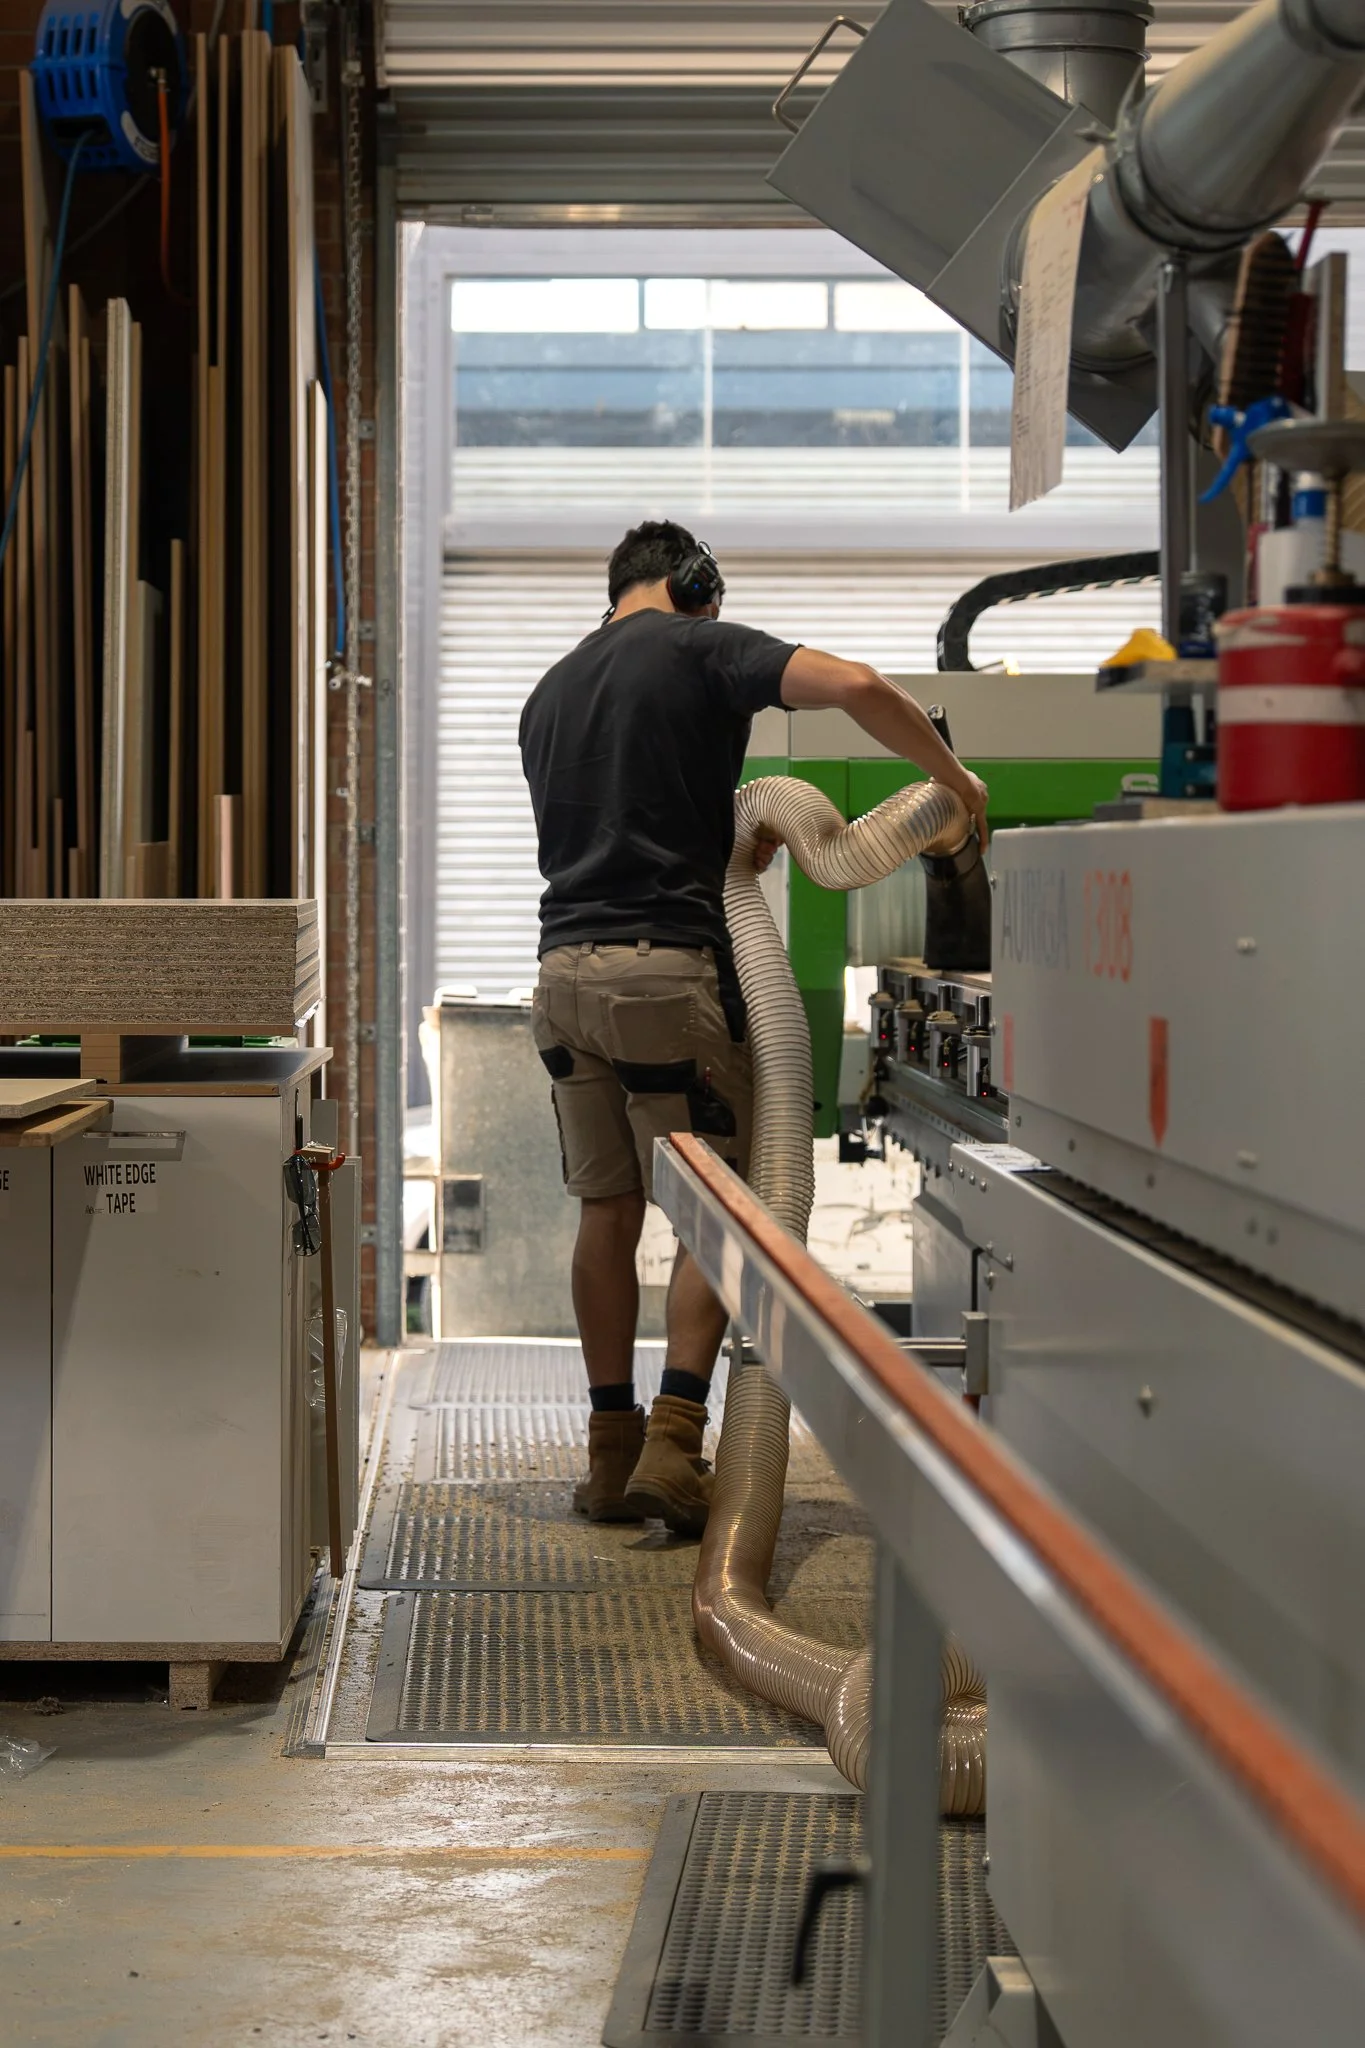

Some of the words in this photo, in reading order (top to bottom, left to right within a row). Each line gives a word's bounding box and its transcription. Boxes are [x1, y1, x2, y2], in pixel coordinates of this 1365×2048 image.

[84, 1164, 123, 1186] WHITE
[126, 1163, 156, 1185] EDGE
[106, 1193, 136, 1214] TAPE
